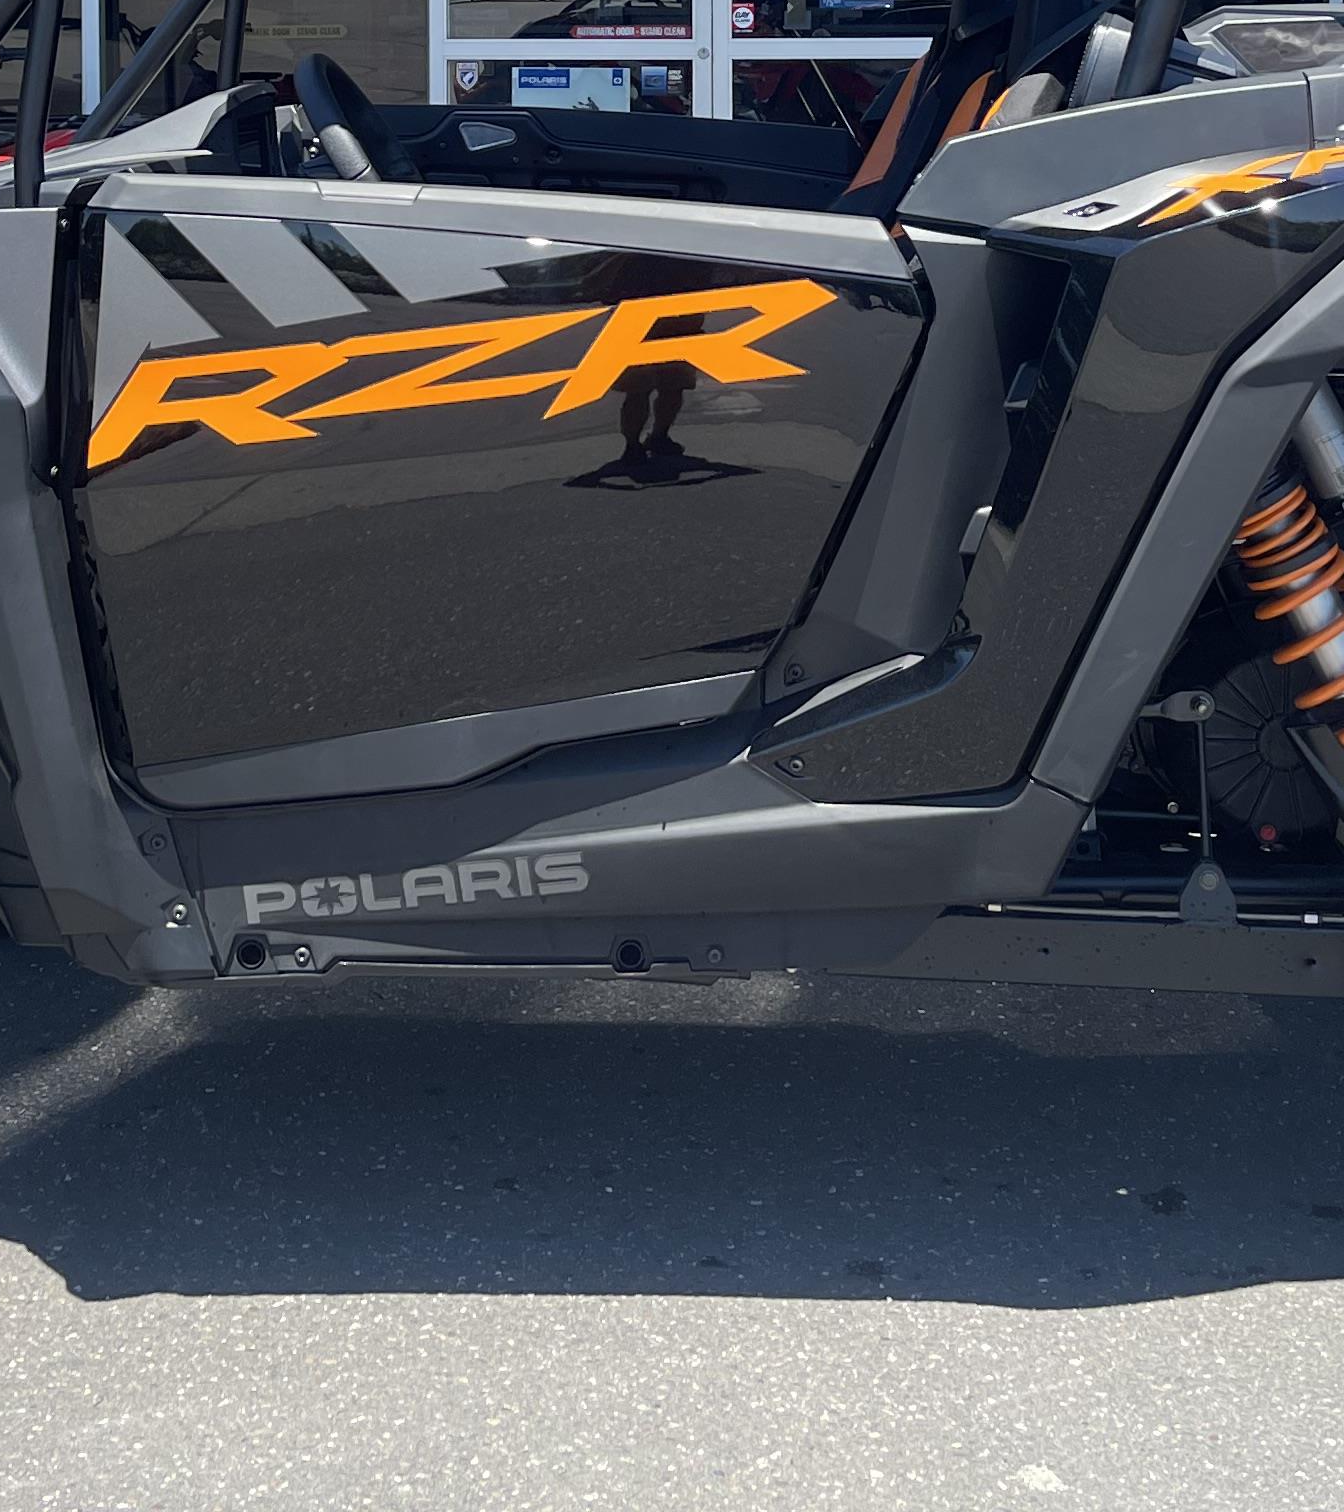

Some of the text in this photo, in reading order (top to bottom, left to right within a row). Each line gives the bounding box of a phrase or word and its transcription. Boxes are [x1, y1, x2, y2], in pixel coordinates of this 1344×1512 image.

[663, 27, 686, 36] CLEAR
[520, 76, 567, 85] POLARIS
[86, 278, 838, 470] RZR
[241, 848, 591, 926] POLARIS
